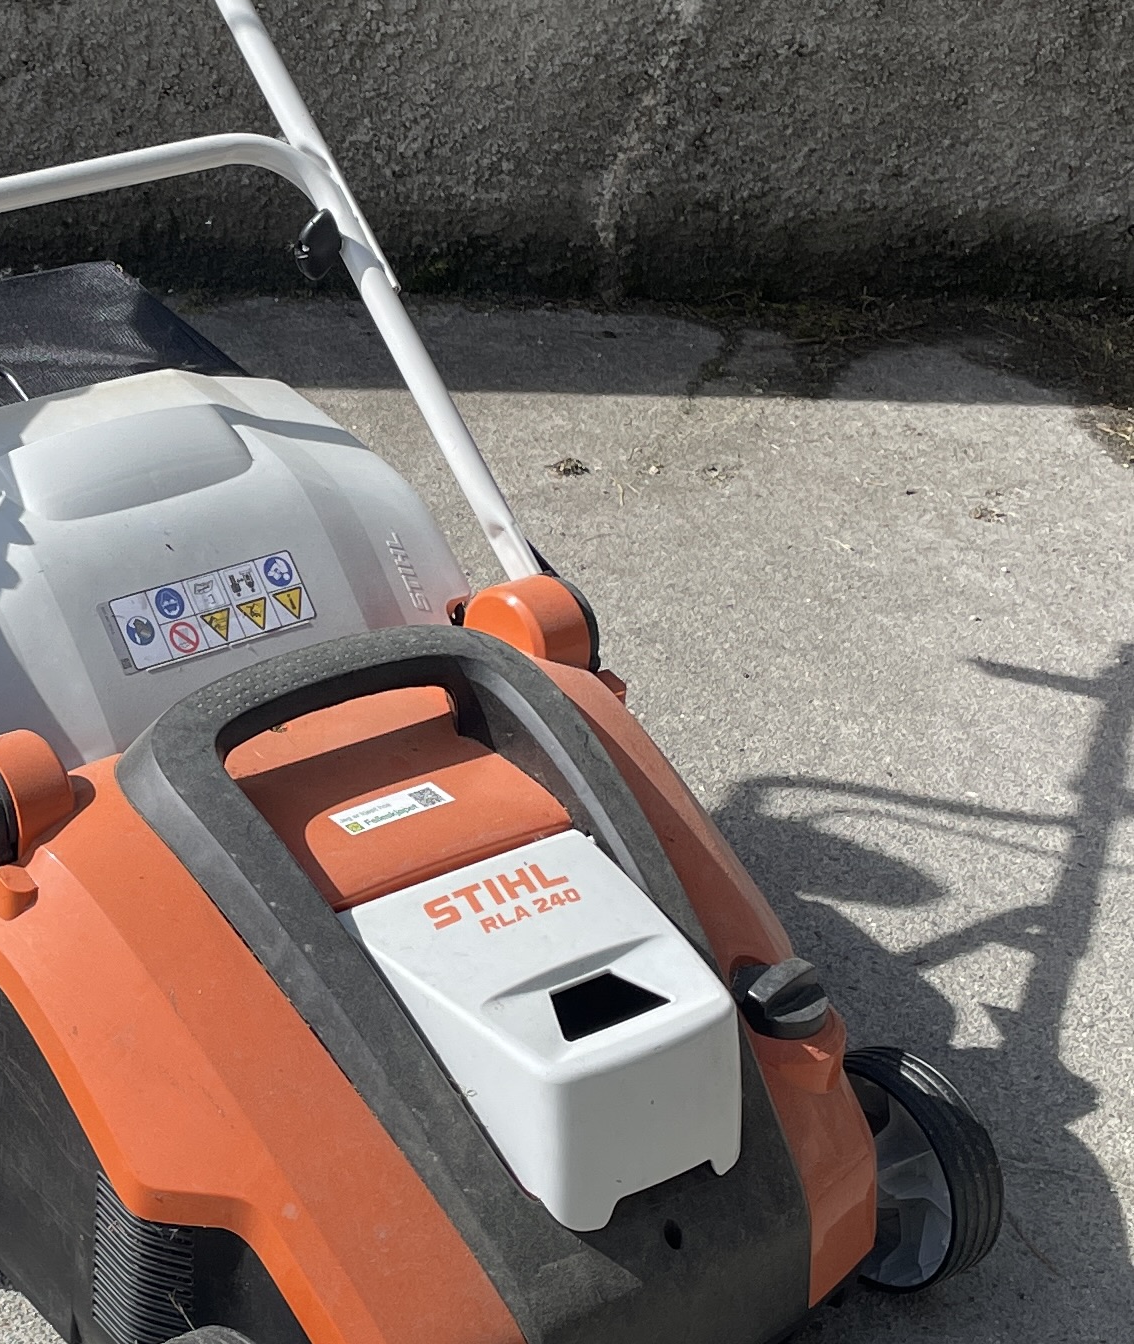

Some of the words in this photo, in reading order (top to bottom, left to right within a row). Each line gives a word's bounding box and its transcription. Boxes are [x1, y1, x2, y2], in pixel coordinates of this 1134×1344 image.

[386, 531, 433, 613] STIHL
[423, 863, 569, 931] STIHL
[479, 905, 532, 934] RLA
[532, 887, 582, 914] 240
